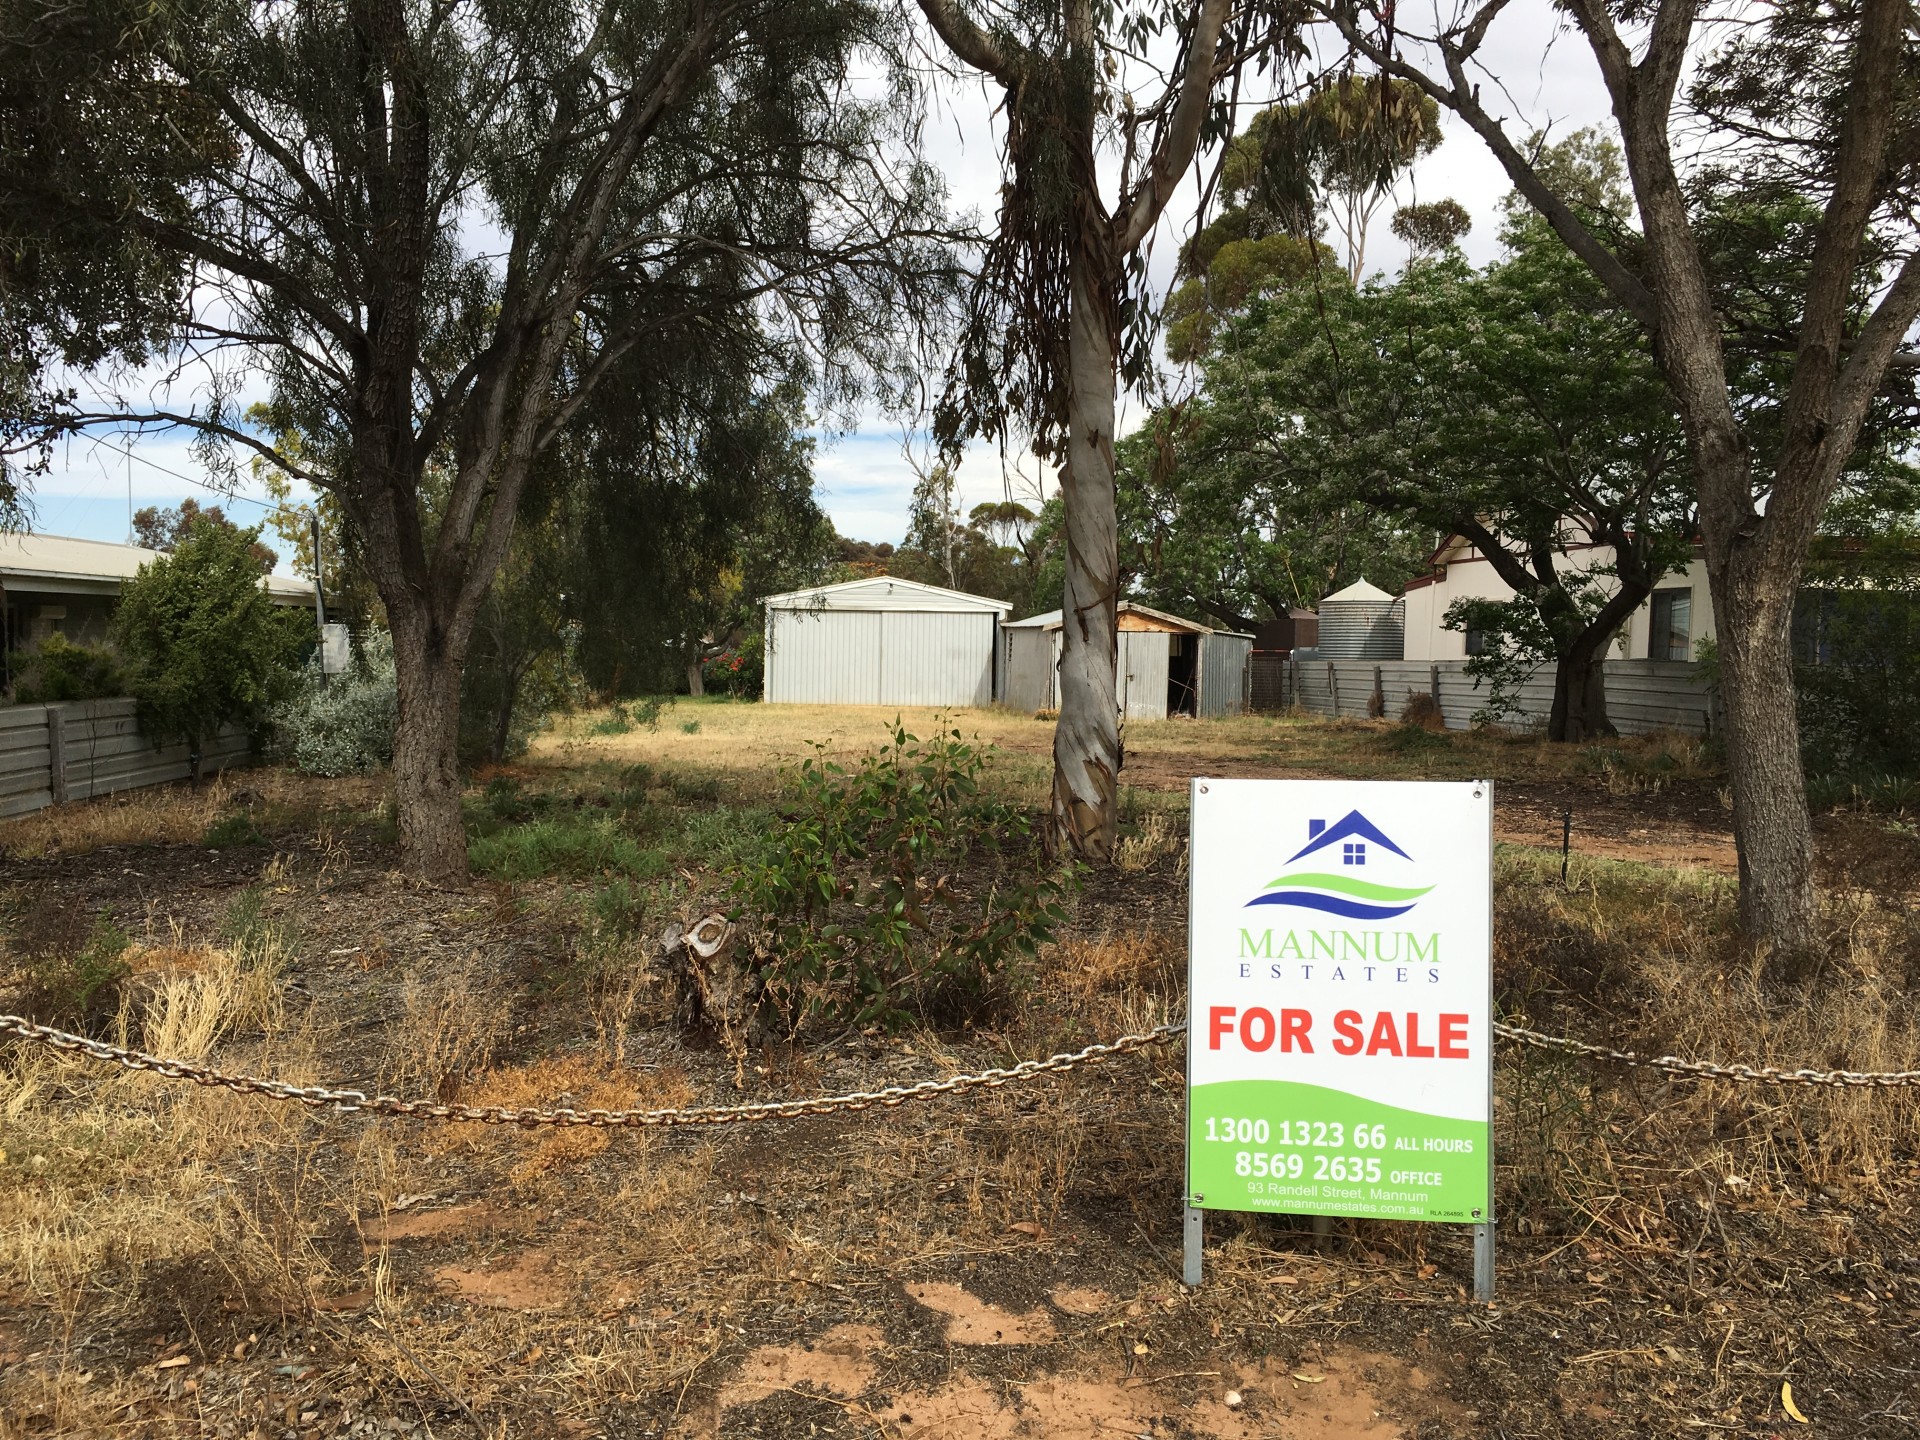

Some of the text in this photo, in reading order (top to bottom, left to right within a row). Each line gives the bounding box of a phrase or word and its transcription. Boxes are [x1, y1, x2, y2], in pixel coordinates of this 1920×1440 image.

[1237, 928, 1443, 963] MANNUM
[1239, 964, 1440, 983] ESTATES
[1209, 1006, 1469, 1059] FOR SALE
[1204, 1117, 1474, 1153] 1300 1323 66 ALL HOURS
[1235, 1151, 1442, 1186] 8569 2635 OFFICE
[1247, 1182, 1428, 1202] 93 Randell Street, Mannum
[1252, 1198, 1424, 1215] www.mannumestates.com.au
